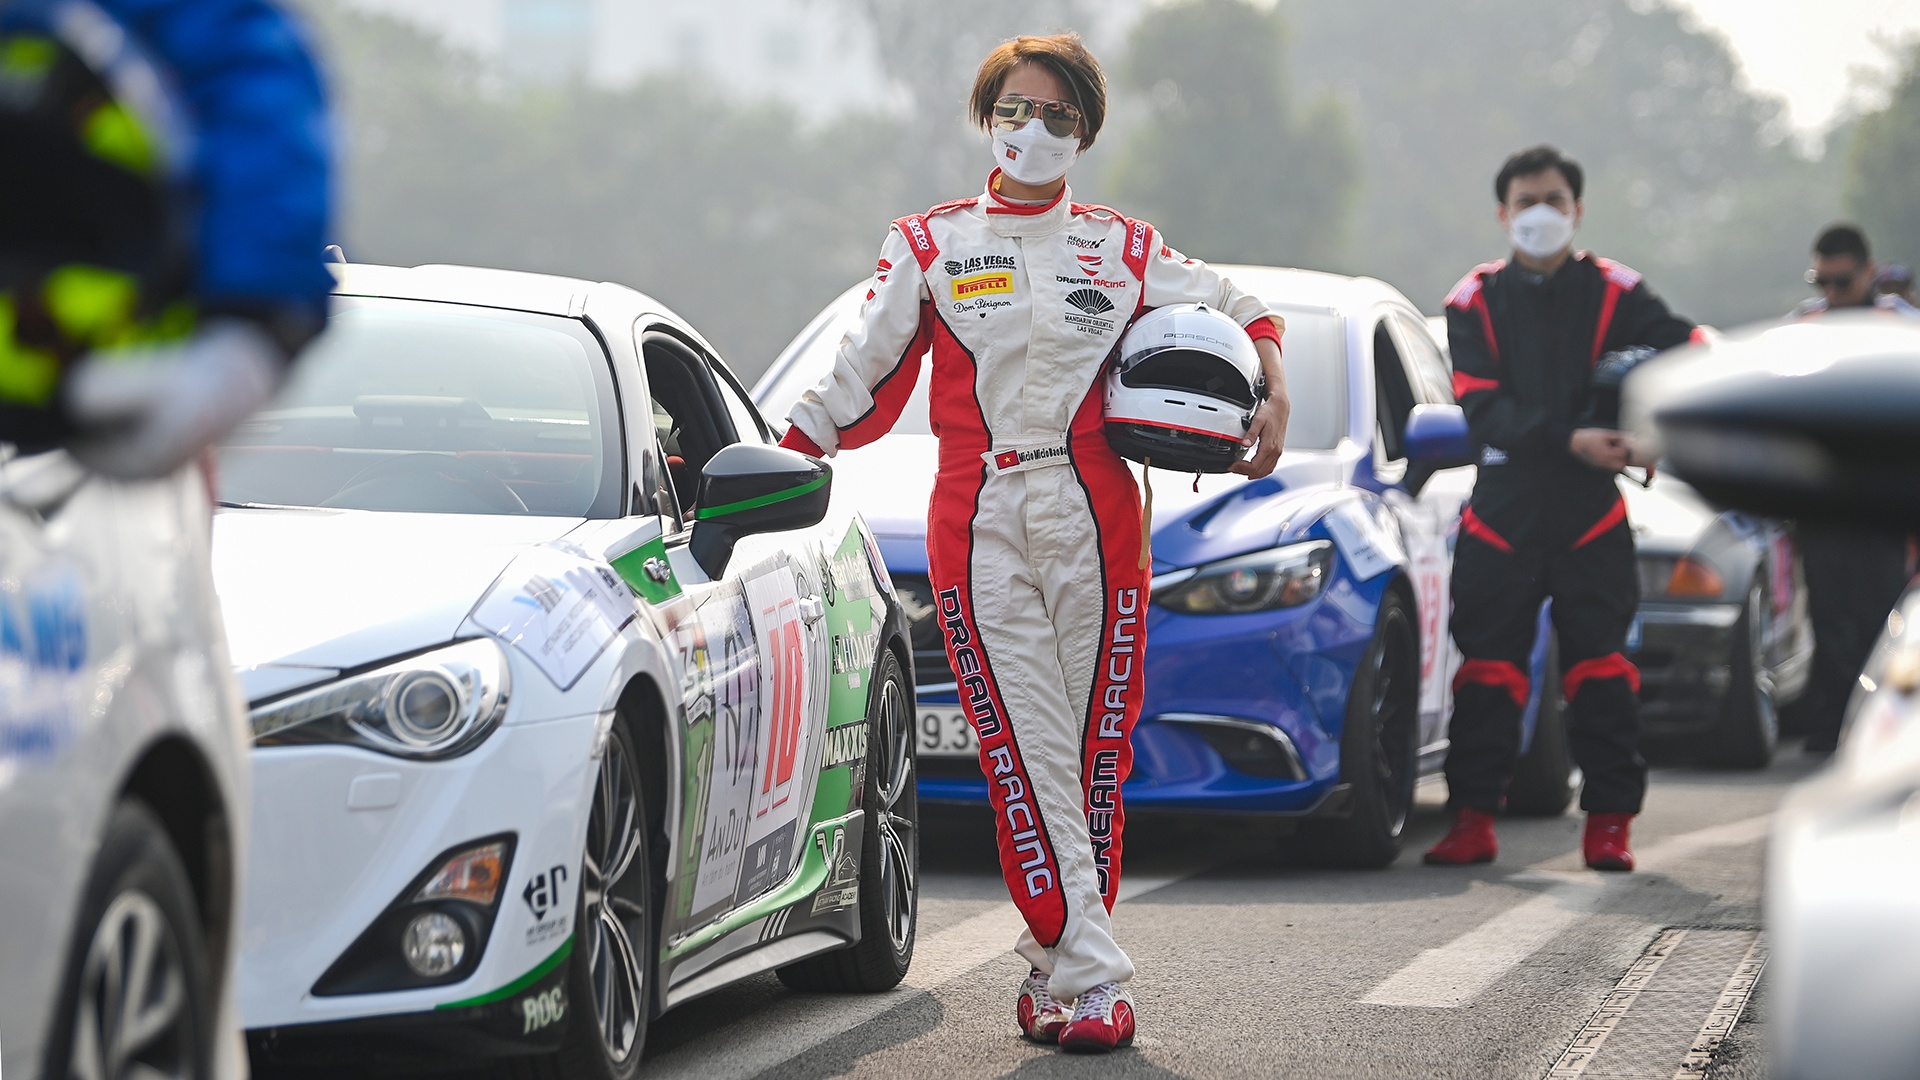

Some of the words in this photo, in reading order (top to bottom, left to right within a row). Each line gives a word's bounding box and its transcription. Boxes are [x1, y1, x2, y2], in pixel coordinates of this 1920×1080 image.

[907, 218, 930, 250] sparco
[1068, 234, 1093, 246] READY
[1131, 223, 1146, 259] sparco
[964, 257, 982, 270] LAS
[983, 255, 1016, 266] VEGAS
[957, 277, 1008, 295] PIRELLI
[1056, 275, 1092, 286] DREAM
[1093, 278, 1127, 289] RACING
[953, 302, 976, 313] Dom
[975, 298, 1012, 311] Pérignon
[1064, 314, 1093, 326] MANDARIN
[1093, 319, 1115, 330] ORIENTAL
[1076, 325, 1087, 333] LAS
[1087, 327, 1103, 336] VEGAS
[1163, 332, 1234, 351] PORSCHE
[1099, 587, 1138, 739] RACING
[821, 721, 868, 768] MAXXIS
[939, 585, 1003, 740] DREAM
[988, 743, 1053, 900] RACING
